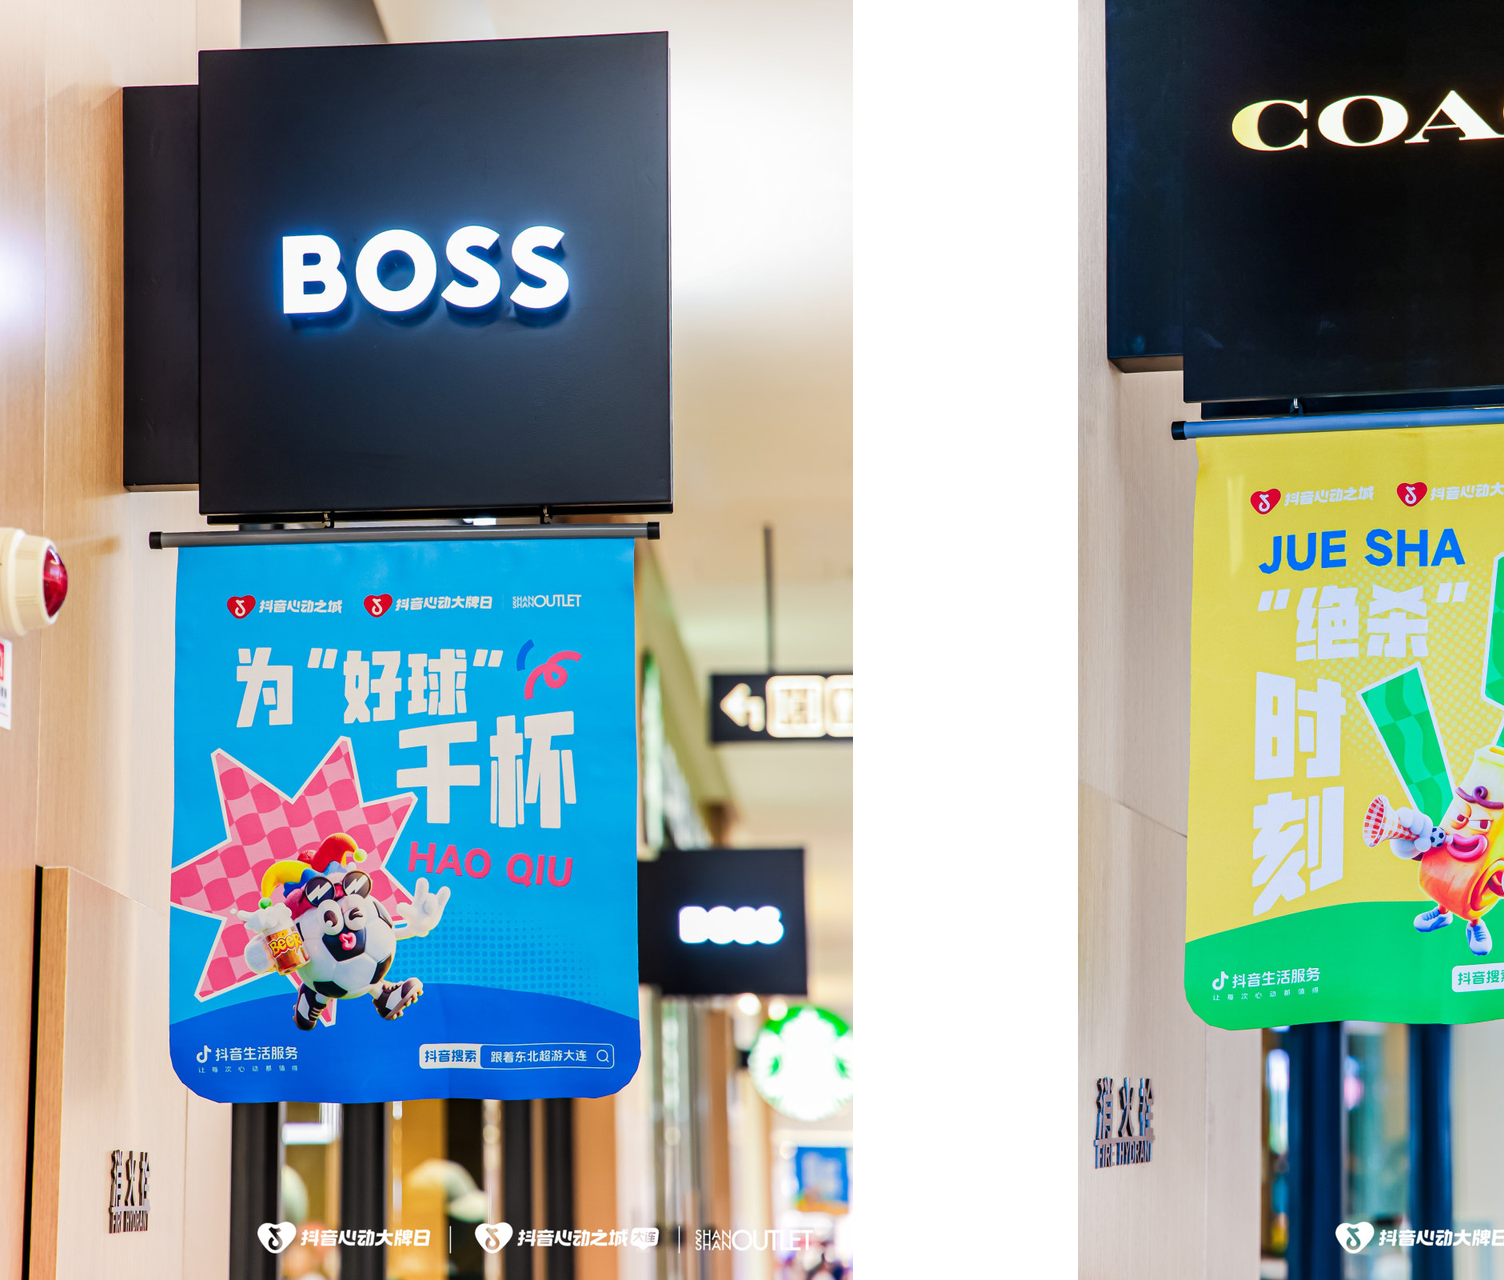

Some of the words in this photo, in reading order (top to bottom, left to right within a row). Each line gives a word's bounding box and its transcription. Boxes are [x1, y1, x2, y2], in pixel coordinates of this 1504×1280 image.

[282, 225, 571, 315] BOSS
[1284, 486, 1374, 507] 抖音心动之城
[1258, 530, 1346, 574] JUE
[1365, 528, 1466, 567] SHA
[259, 599, 343, 614] 抖音心动之城
[395, 596, 493, 611] 抖音心动大牌日
[534, 594, 582, 608] OUTLET
[396, 711, 577, 829] 干杯
[1252, 671, 1346, 917] 时刻
[408, 842, 491, 879] HAO
[506, 853, 573, 888] QIU
[1232, 967, 1320, 988] 抖音生活服务
[215, 1046, 298, 1061] 抖音生活服务
[425, 1049, 477, 1062] 抖音搜索
[490, 1049, 587, 1063] 跟着东北超游大连
